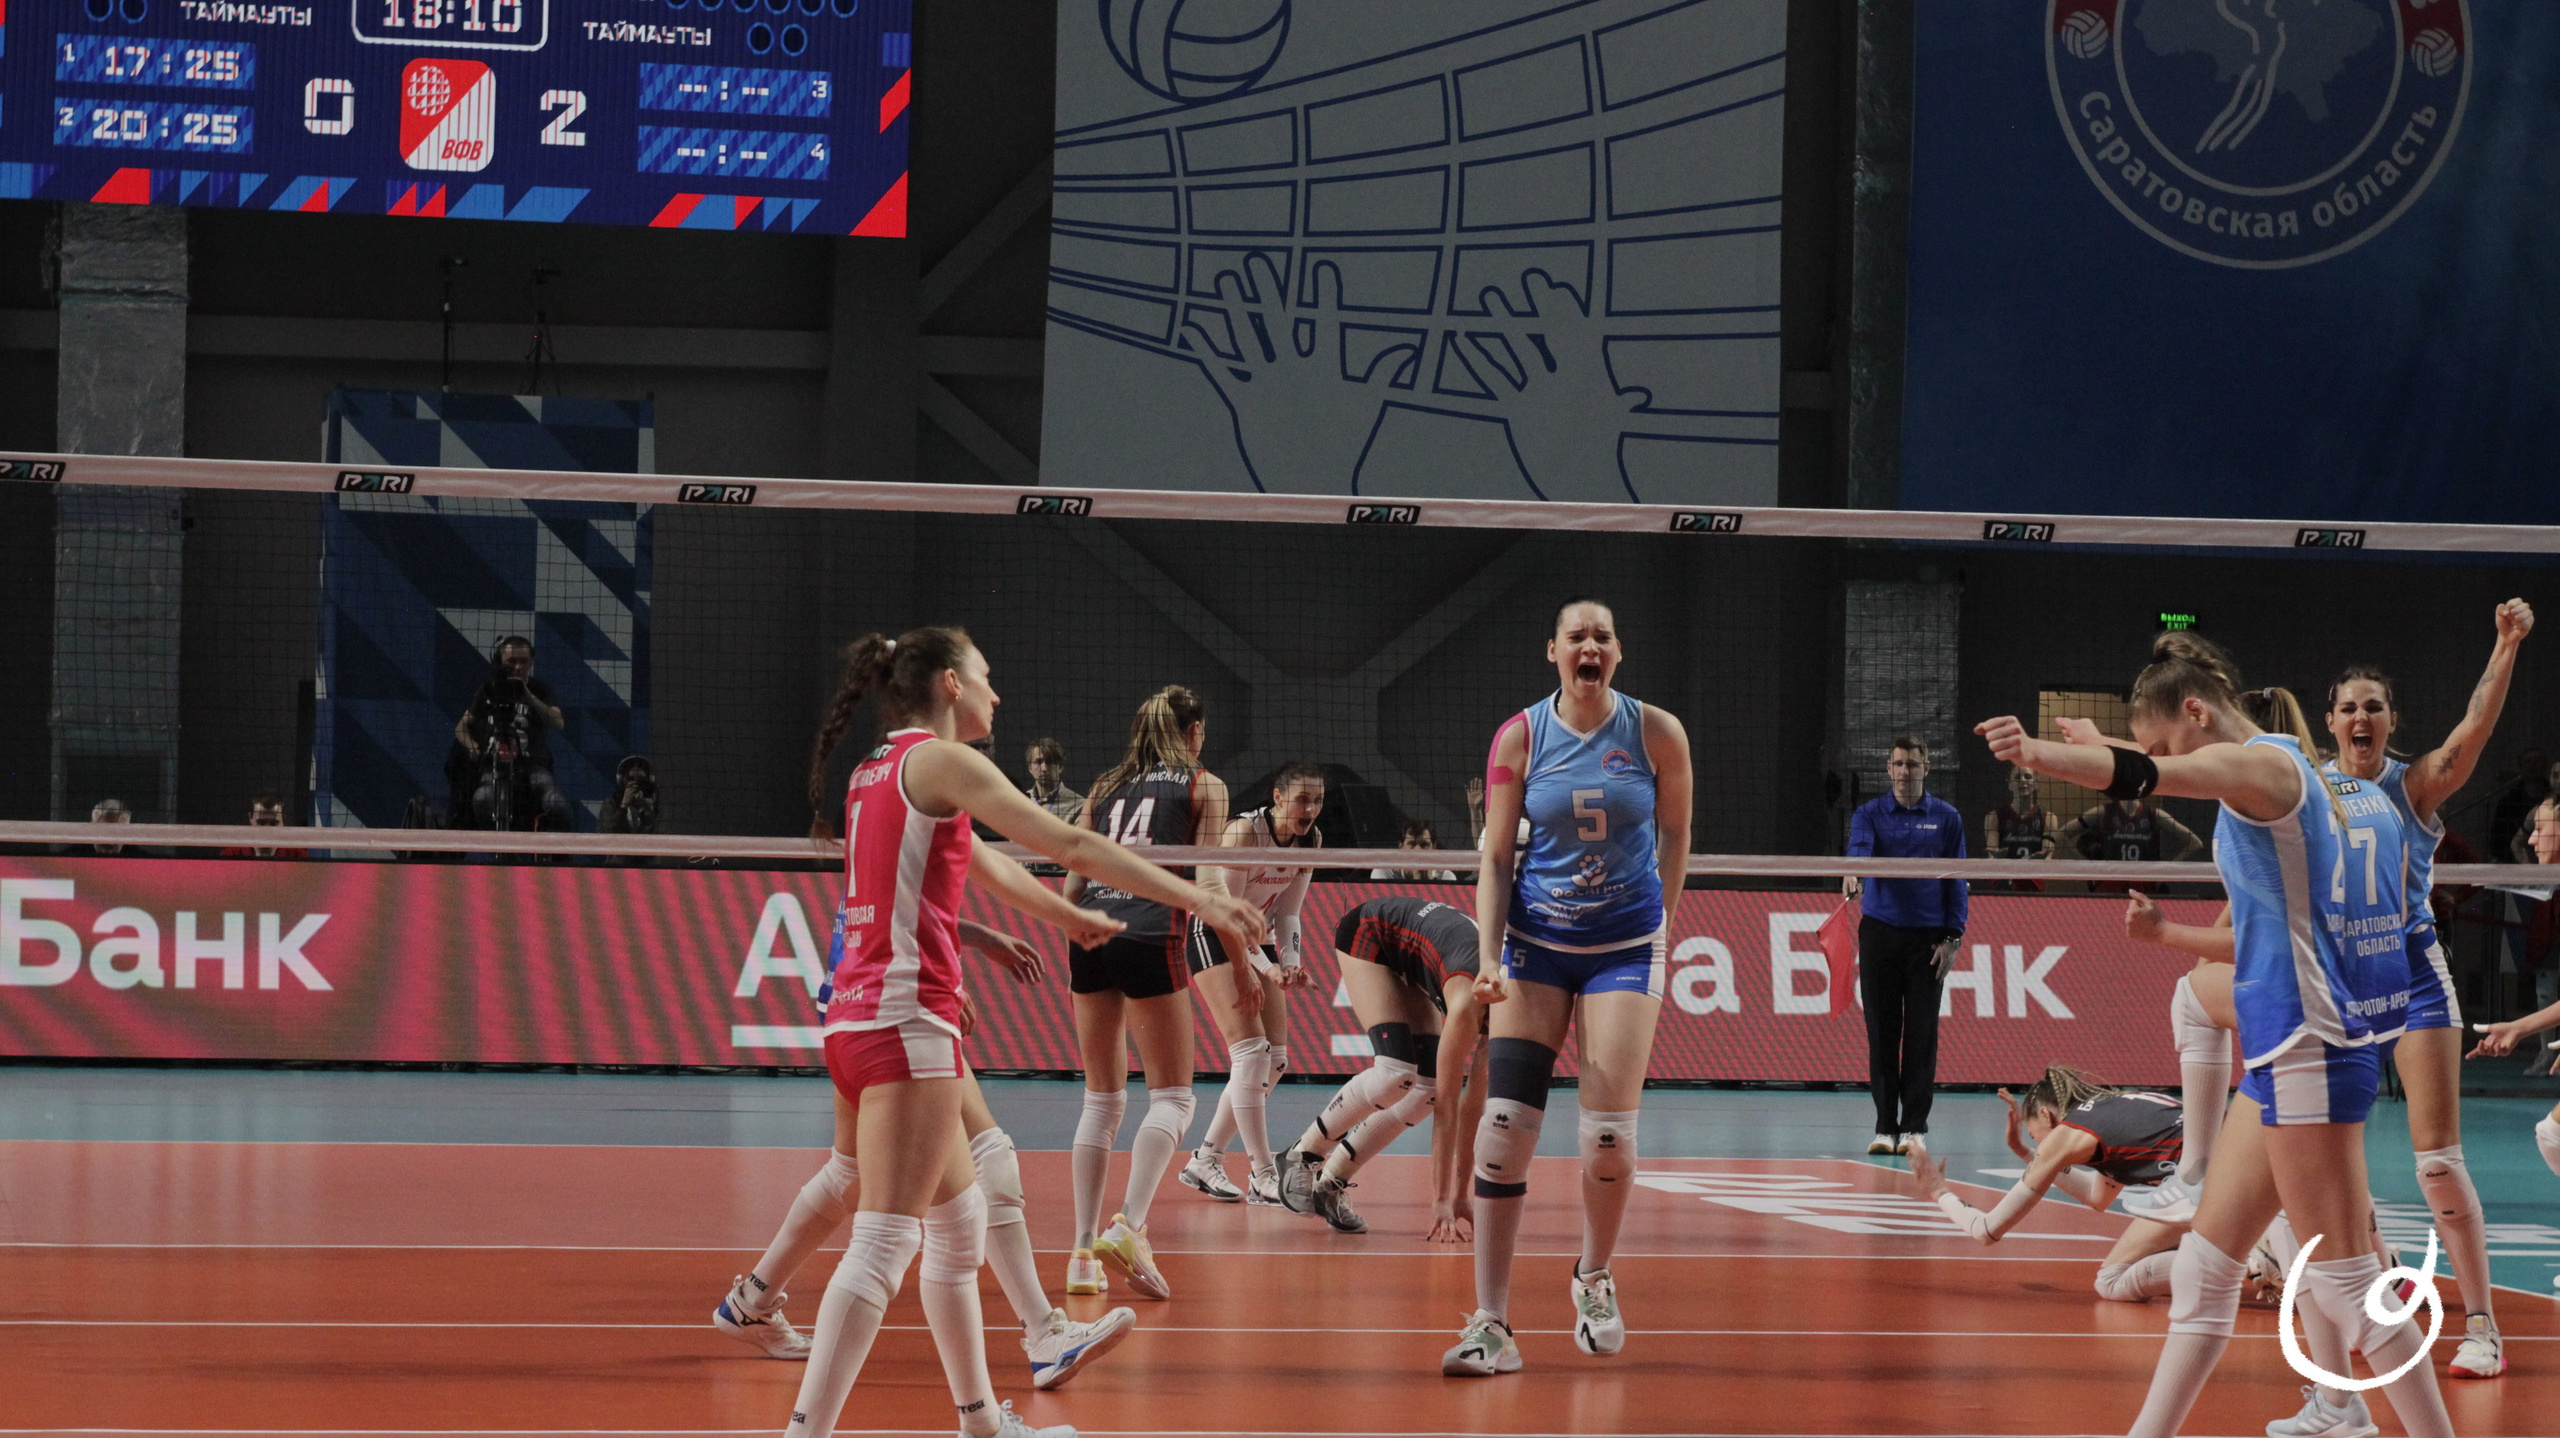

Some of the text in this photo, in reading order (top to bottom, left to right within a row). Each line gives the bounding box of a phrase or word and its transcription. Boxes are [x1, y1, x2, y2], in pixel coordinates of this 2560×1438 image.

[180, 0, 312, 27] ТАЙМАУТЫ
[583, 20, 712, 47] ТАЙМАУТЫ
[63, 43, 75, 62] 1
[811, 80, 828, 98] 3
[59, 107, 74, 126] 2
[304, 77, 355, 136] 0
[540, 89, 588, 147] 2
[441, 138, 484, 161] ВФВ
[810, 143, 825, 161] 4
[2079, 90, 2439, 239] Саратовская область
[0, 461, 60, 480] PARI
[341, 473, 409, 492] PARI
[684, 485, 751, 503] PARI
[1022, 497, 1087, 515] PARI
[1352, 506, 1415, 523] PARI
[1675, 514, 1737, 531] PARI
[1989, 523, 2050, 541] PARI
[2300, 530, 2360, 547] PARI
[1107, 796, 1157, 846] 14
[1571, 788, 1608, 842] 5
[2348, 826, 2378, 906] 7
[0, 878, 334, 992] Банк
[2356, 934, 2402, 957] ОБЛАСТЬ
[1511, 948, 1527, 968] 5
[1769, 912, 2076, 1020] Бнк
